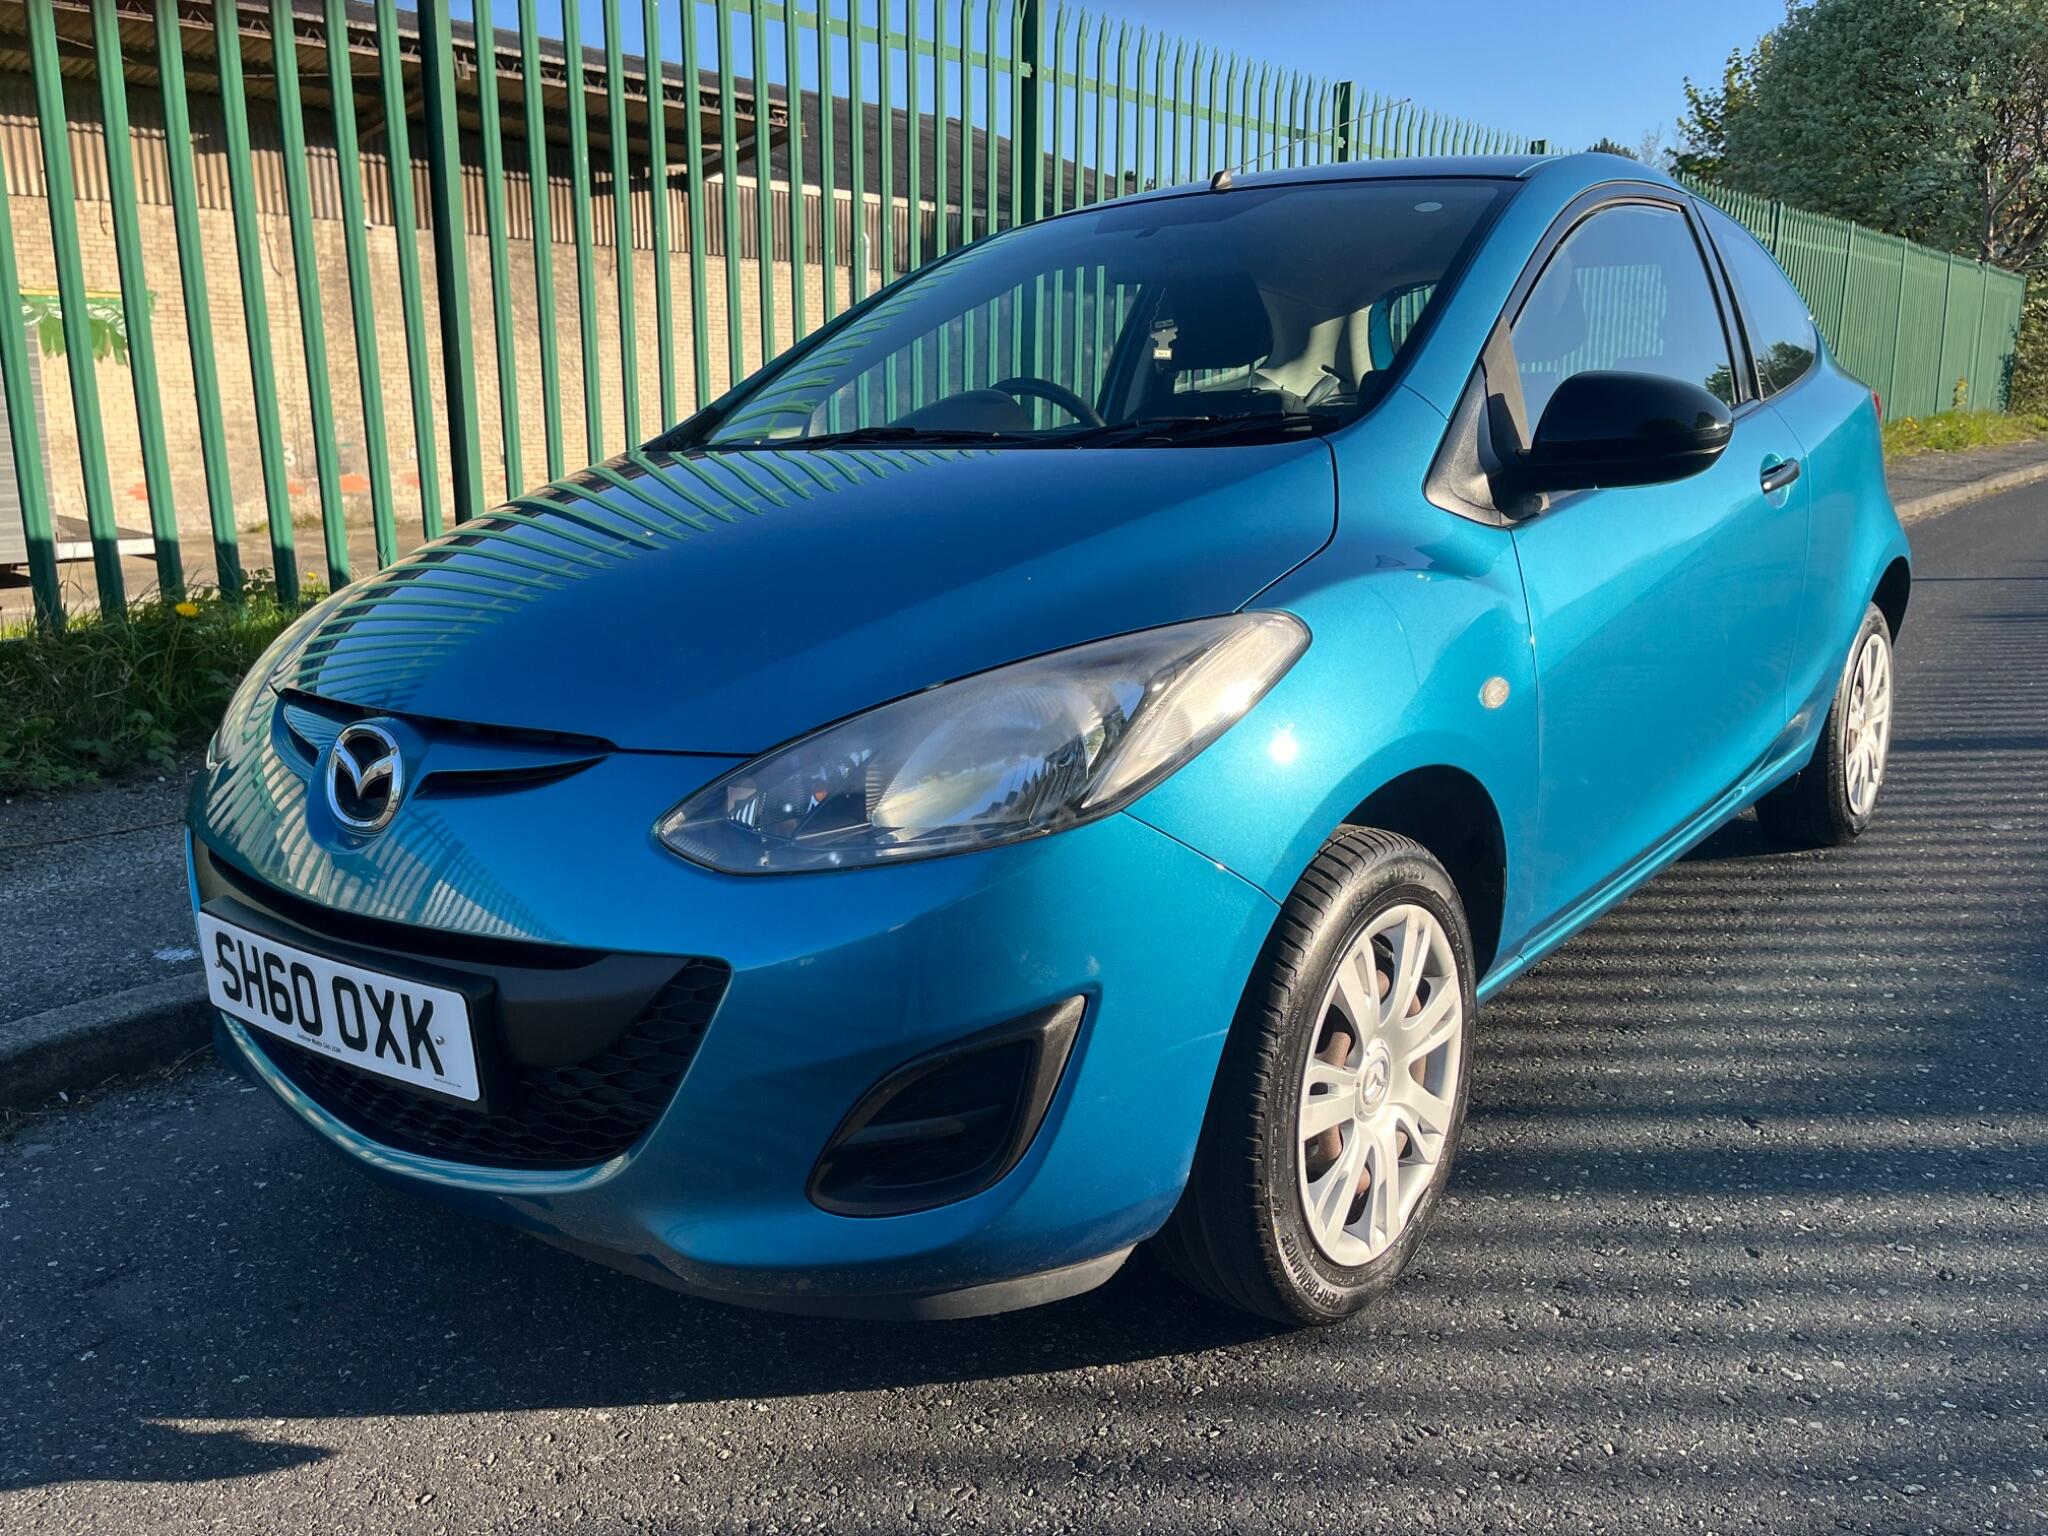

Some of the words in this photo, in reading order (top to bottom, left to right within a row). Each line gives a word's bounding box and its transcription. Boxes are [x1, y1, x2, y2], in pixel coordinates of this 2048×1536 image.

[216, 931, 323, 1037] SH60
[332, 975, 445, 1077] OXK
[1280, 1232, 1344, 1310] PERFORMANCE
